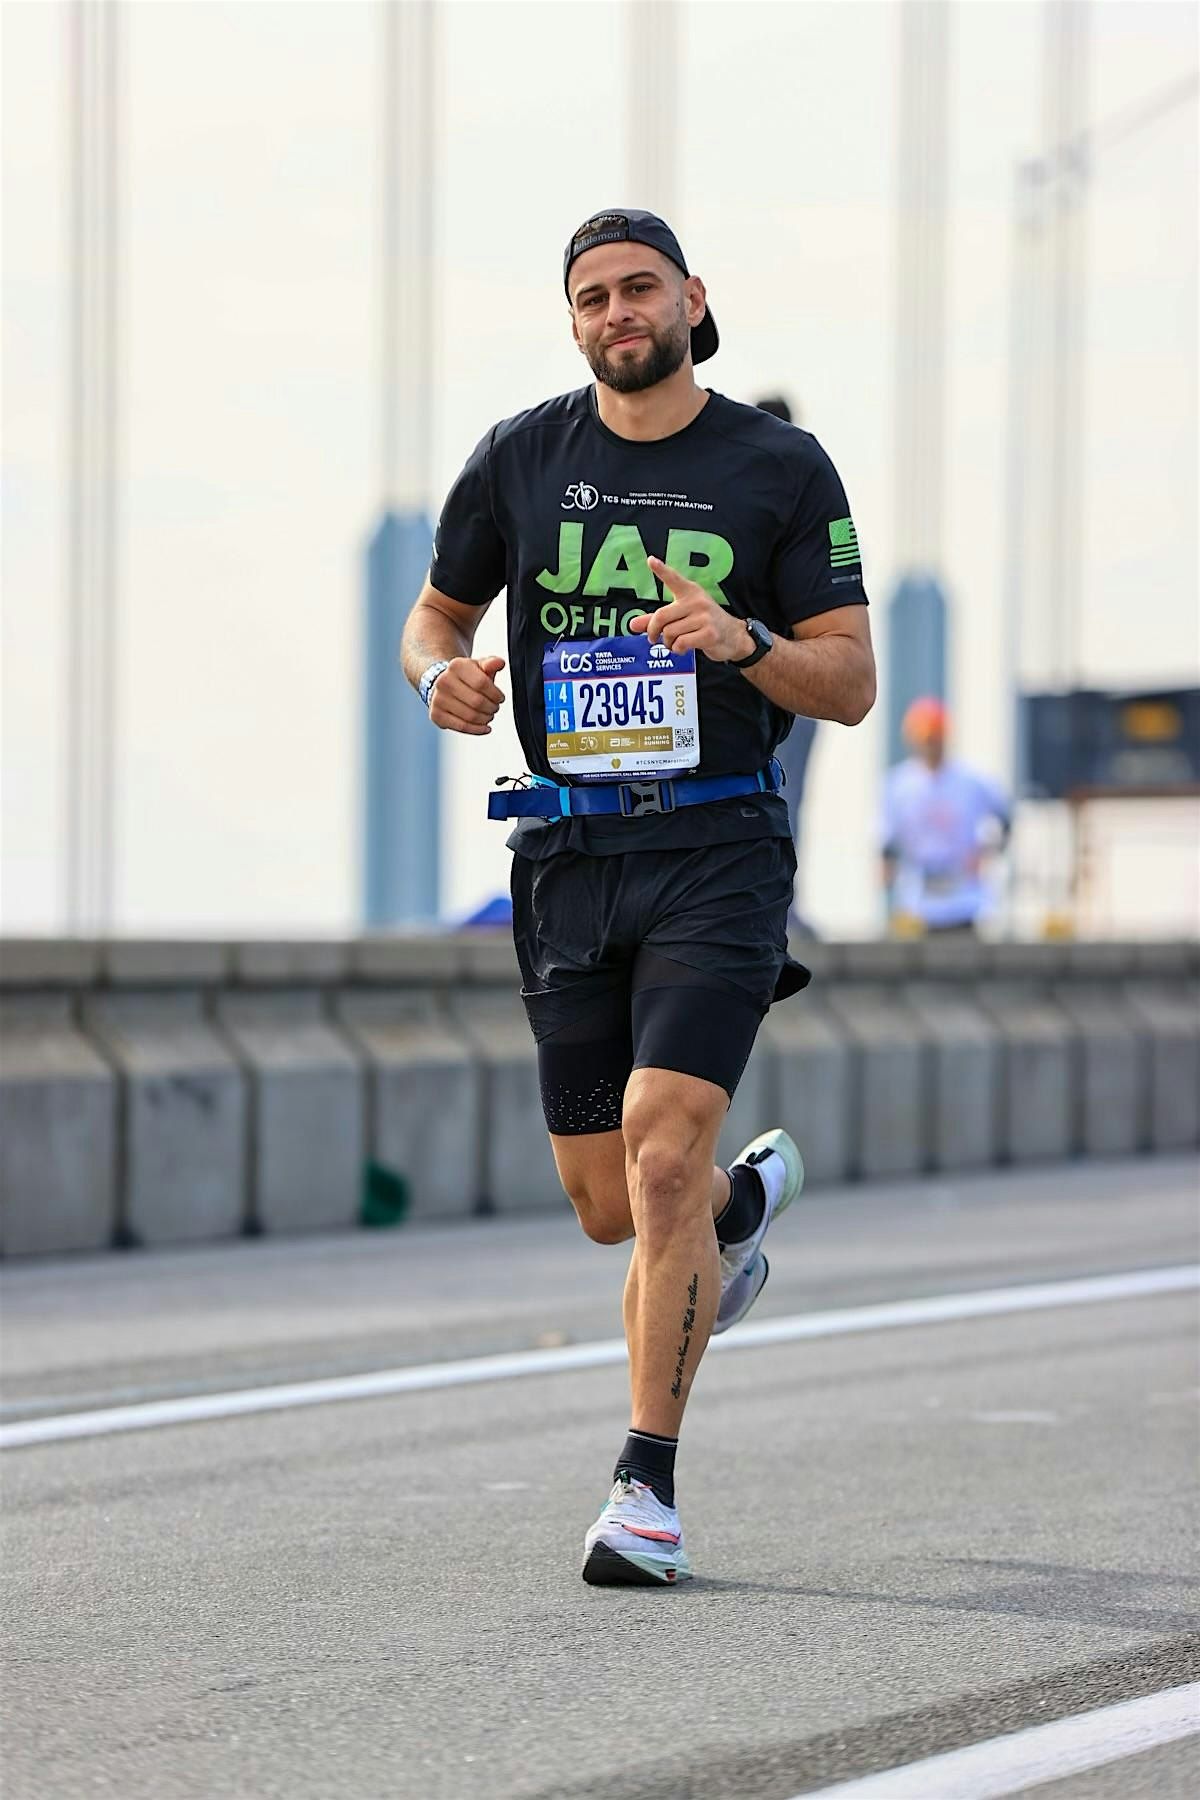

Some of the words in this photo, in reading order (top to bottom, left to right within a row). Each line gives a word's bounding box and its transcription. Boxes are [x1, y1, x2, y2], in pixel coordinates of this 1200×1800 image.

[602, 495, 619, 503] TCS
[674, 501, 713, 511] MARATHON
[535, 521, 734, 605] JAR
[540, 601, 585, 637] OF
[560, 650, 593, 673] tcs
[595, 656, 635, 665] CONSULTANCY
[647, 660, 674, 669] TATA
[559, 683, 567, 703] 4
[675, 685, 686, 716] 2021
[580, 680, 664, 728] 23945
[560, 710, 569, 730] B
